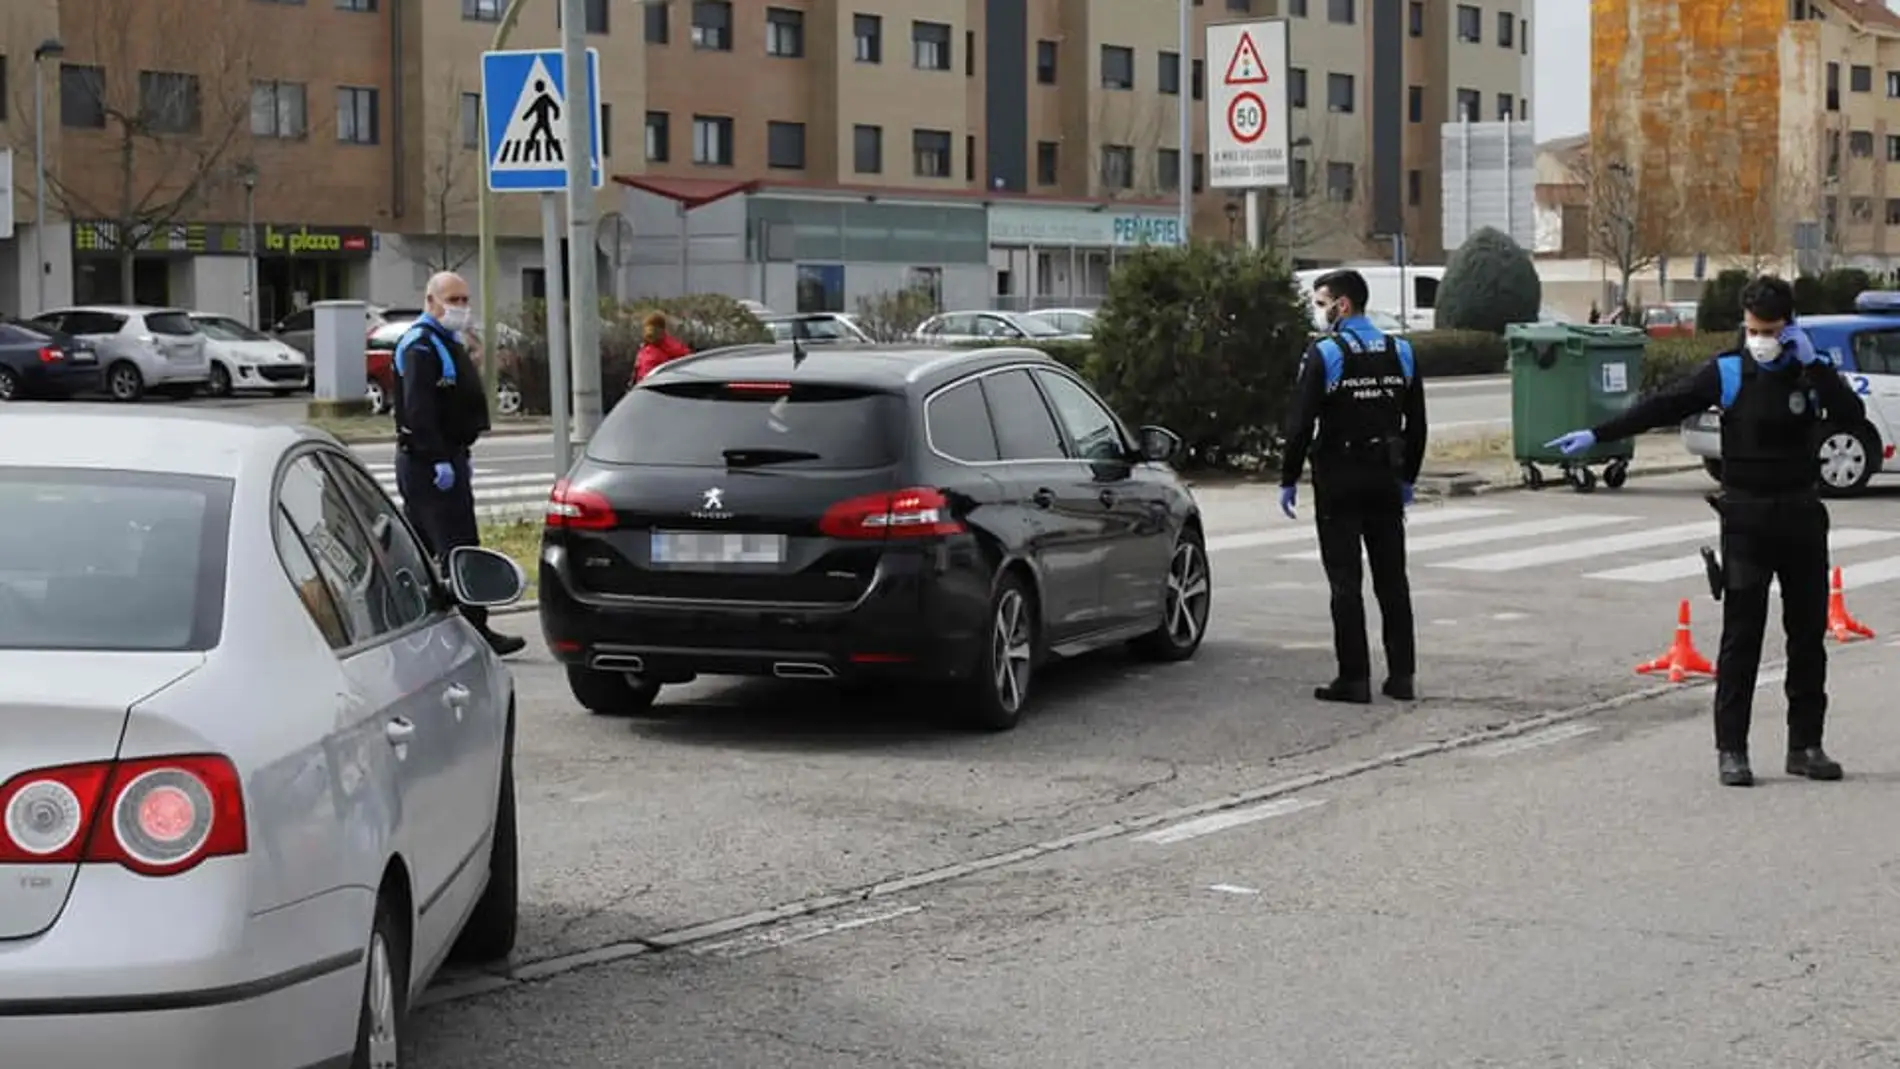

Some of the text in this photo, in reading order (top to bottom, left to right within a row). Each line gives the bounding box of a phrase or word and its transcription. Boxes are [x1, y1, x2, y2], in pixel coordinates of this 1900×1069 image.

[1236, 106, 1258, 127] 50
[265, 224, 341, 256] la plaza
[1114, 214, 1182, 242] PEÑAFIEL
